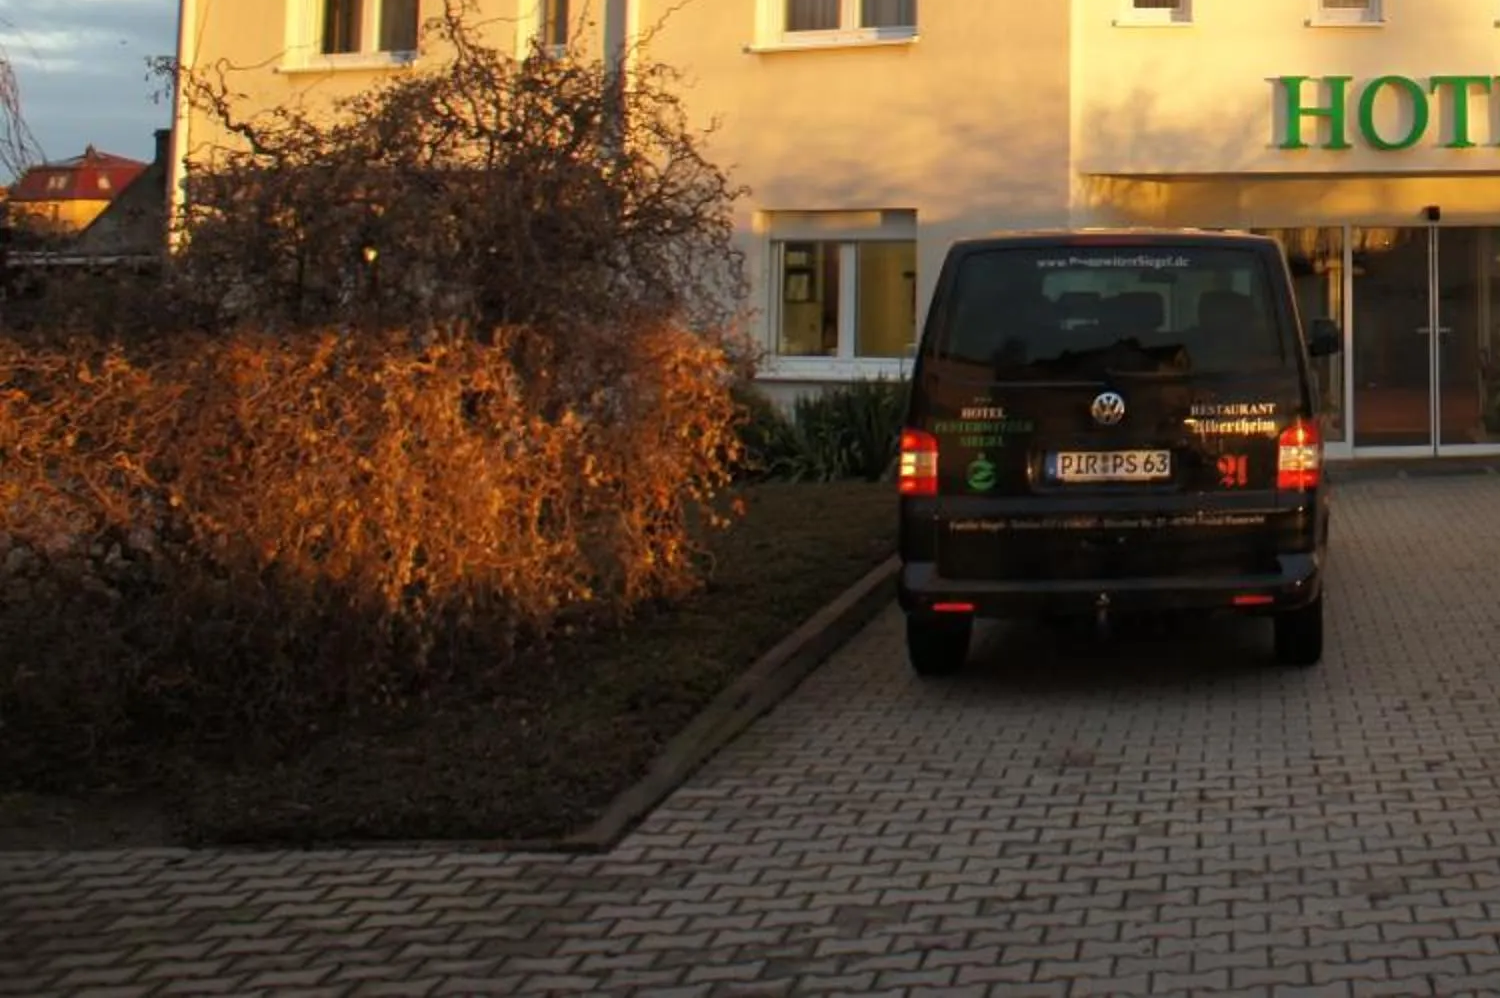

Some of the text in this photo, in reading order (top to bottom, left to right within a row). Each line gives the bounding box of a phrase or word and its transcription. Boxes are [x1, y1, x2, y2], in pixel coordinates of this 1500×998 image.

[961, 407, 1006, 419] HOTEL
[1191, 402, 1276, 415] RESTAURANT
[1061, 451, 1169, 476] PIR PS 63
